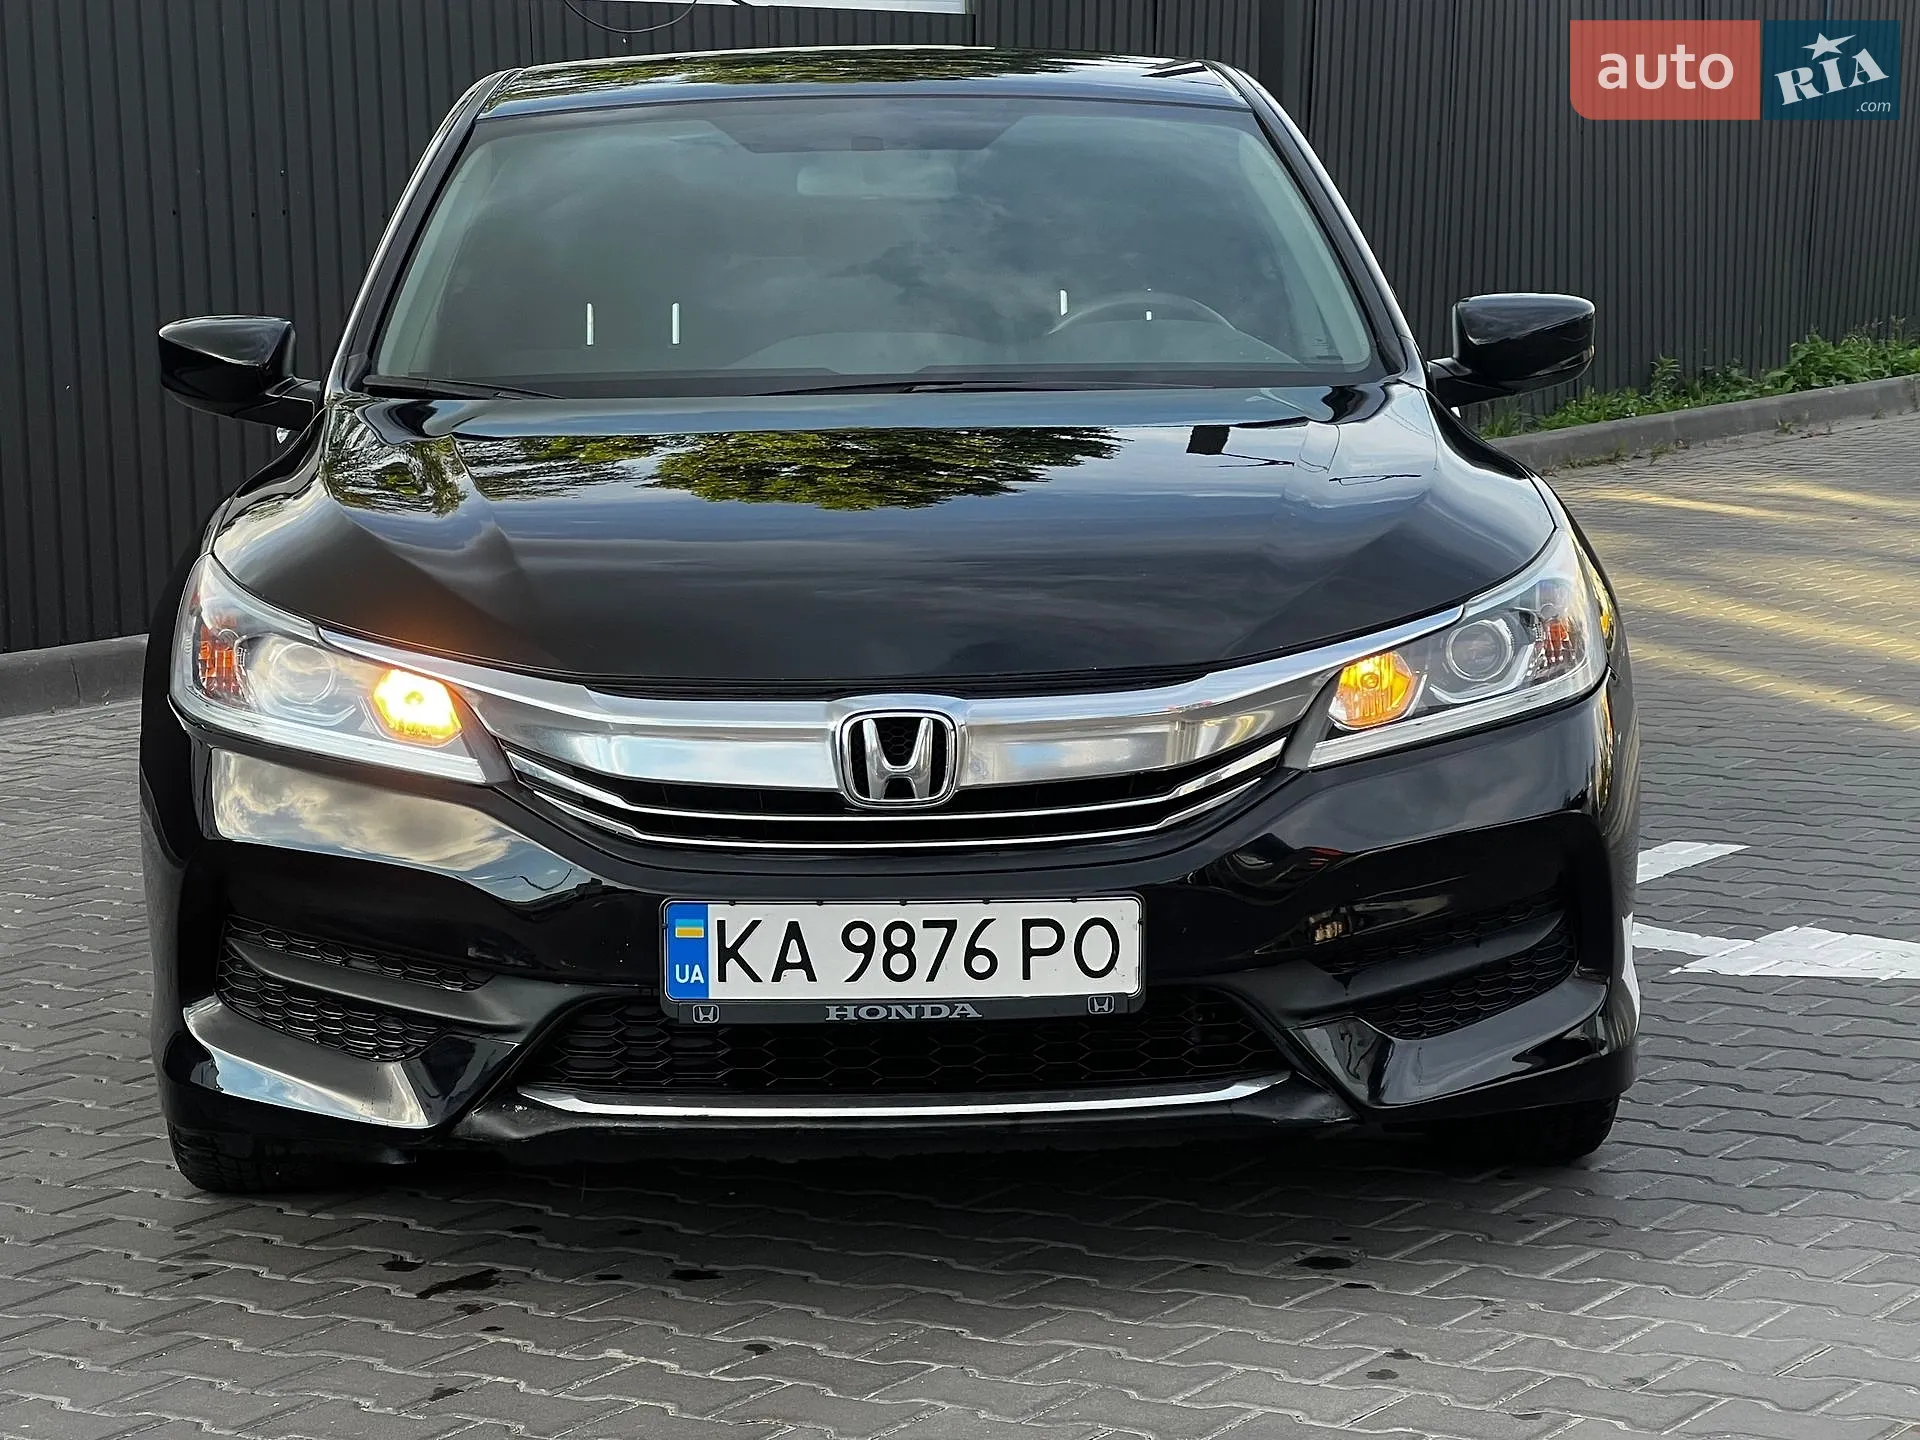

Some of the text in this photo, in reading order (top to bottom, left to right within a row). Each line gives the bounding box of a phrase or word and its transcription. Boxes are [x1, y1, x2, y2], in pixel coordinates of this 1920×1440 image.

[716, 916, 1121, 982] KA 9876 PO
[675, 964, 704, 983] UA
[824, 1002, 982, 1022] HONDA
